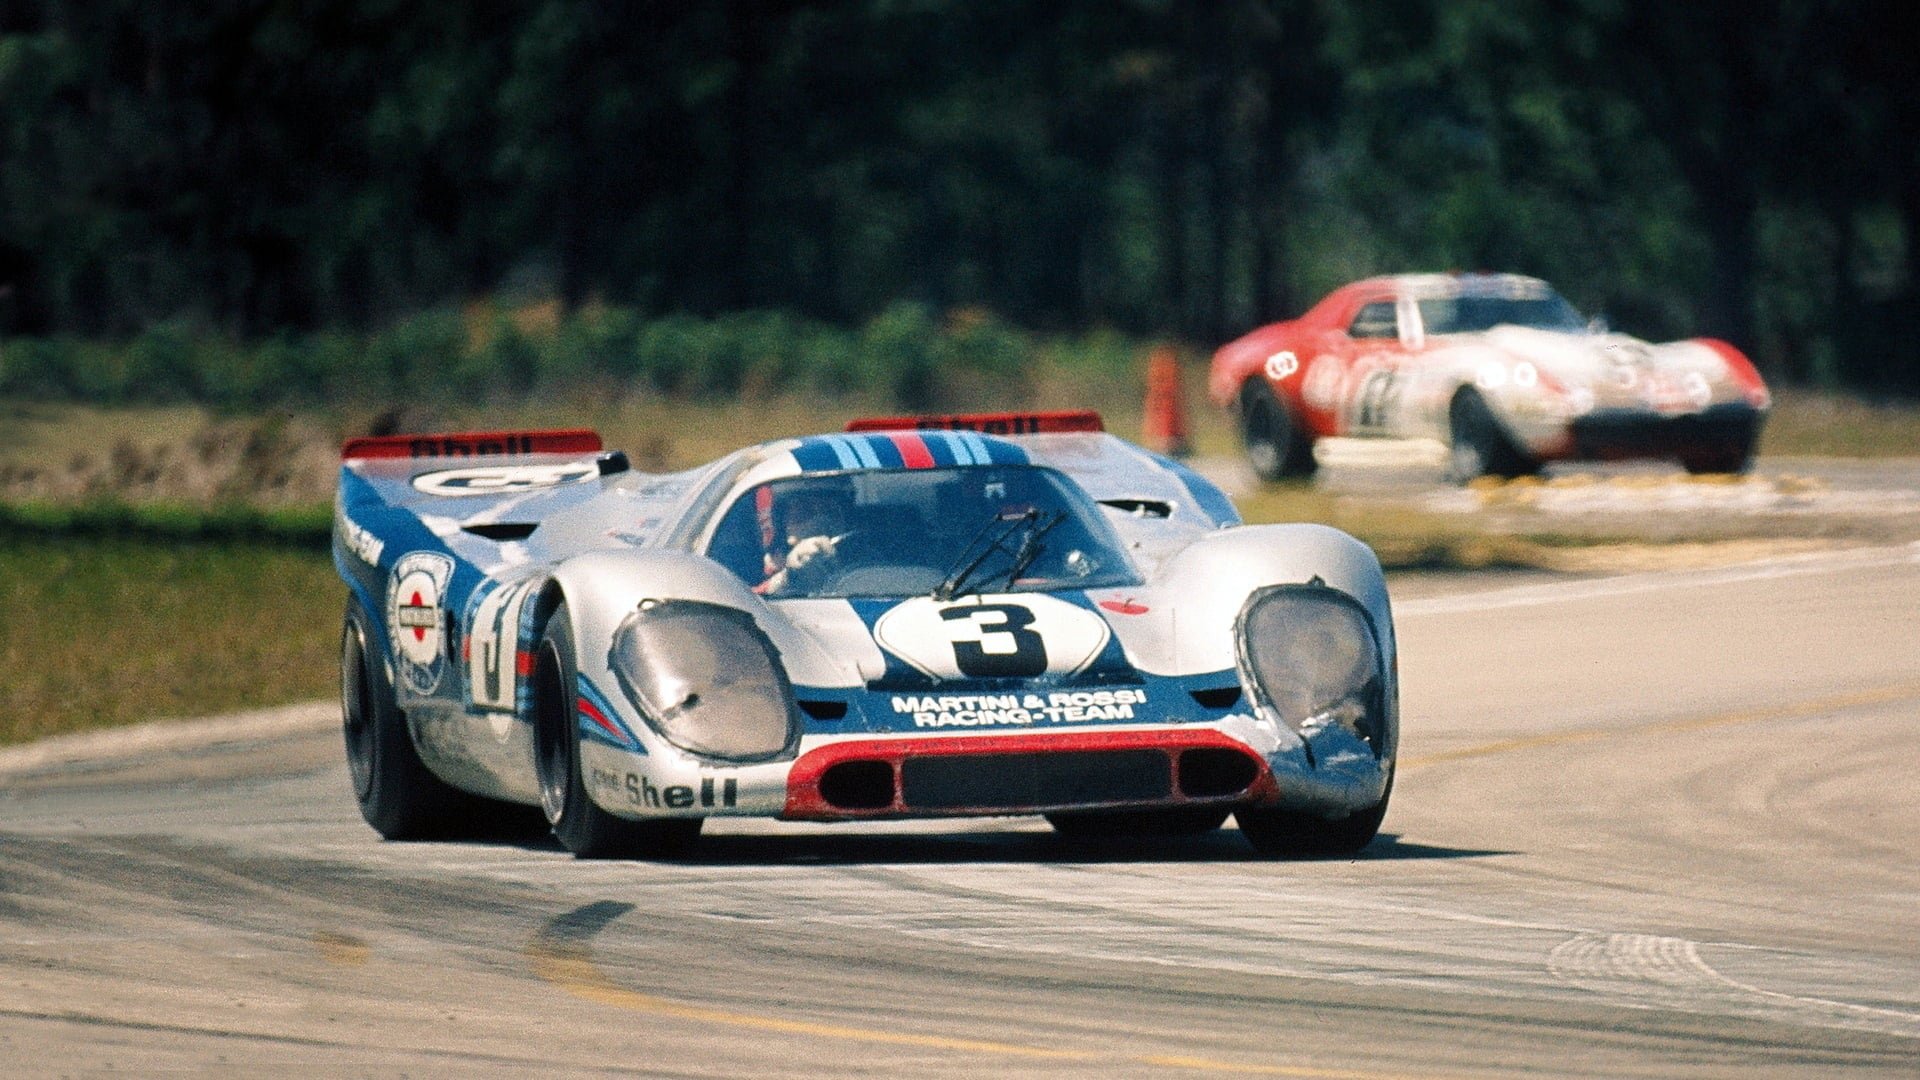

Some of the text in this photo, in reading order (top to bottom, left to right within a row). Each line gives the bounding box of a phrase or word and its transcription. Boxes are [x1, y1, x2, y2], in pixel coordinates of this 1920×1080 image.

[939, 602, 1048, 678] 3
[891, 689, 1147, 713] MARTINI & ROSSI
[913, 704, 1135, 727] RACING-TEAM
[625, 773, 738, 808] Shell
